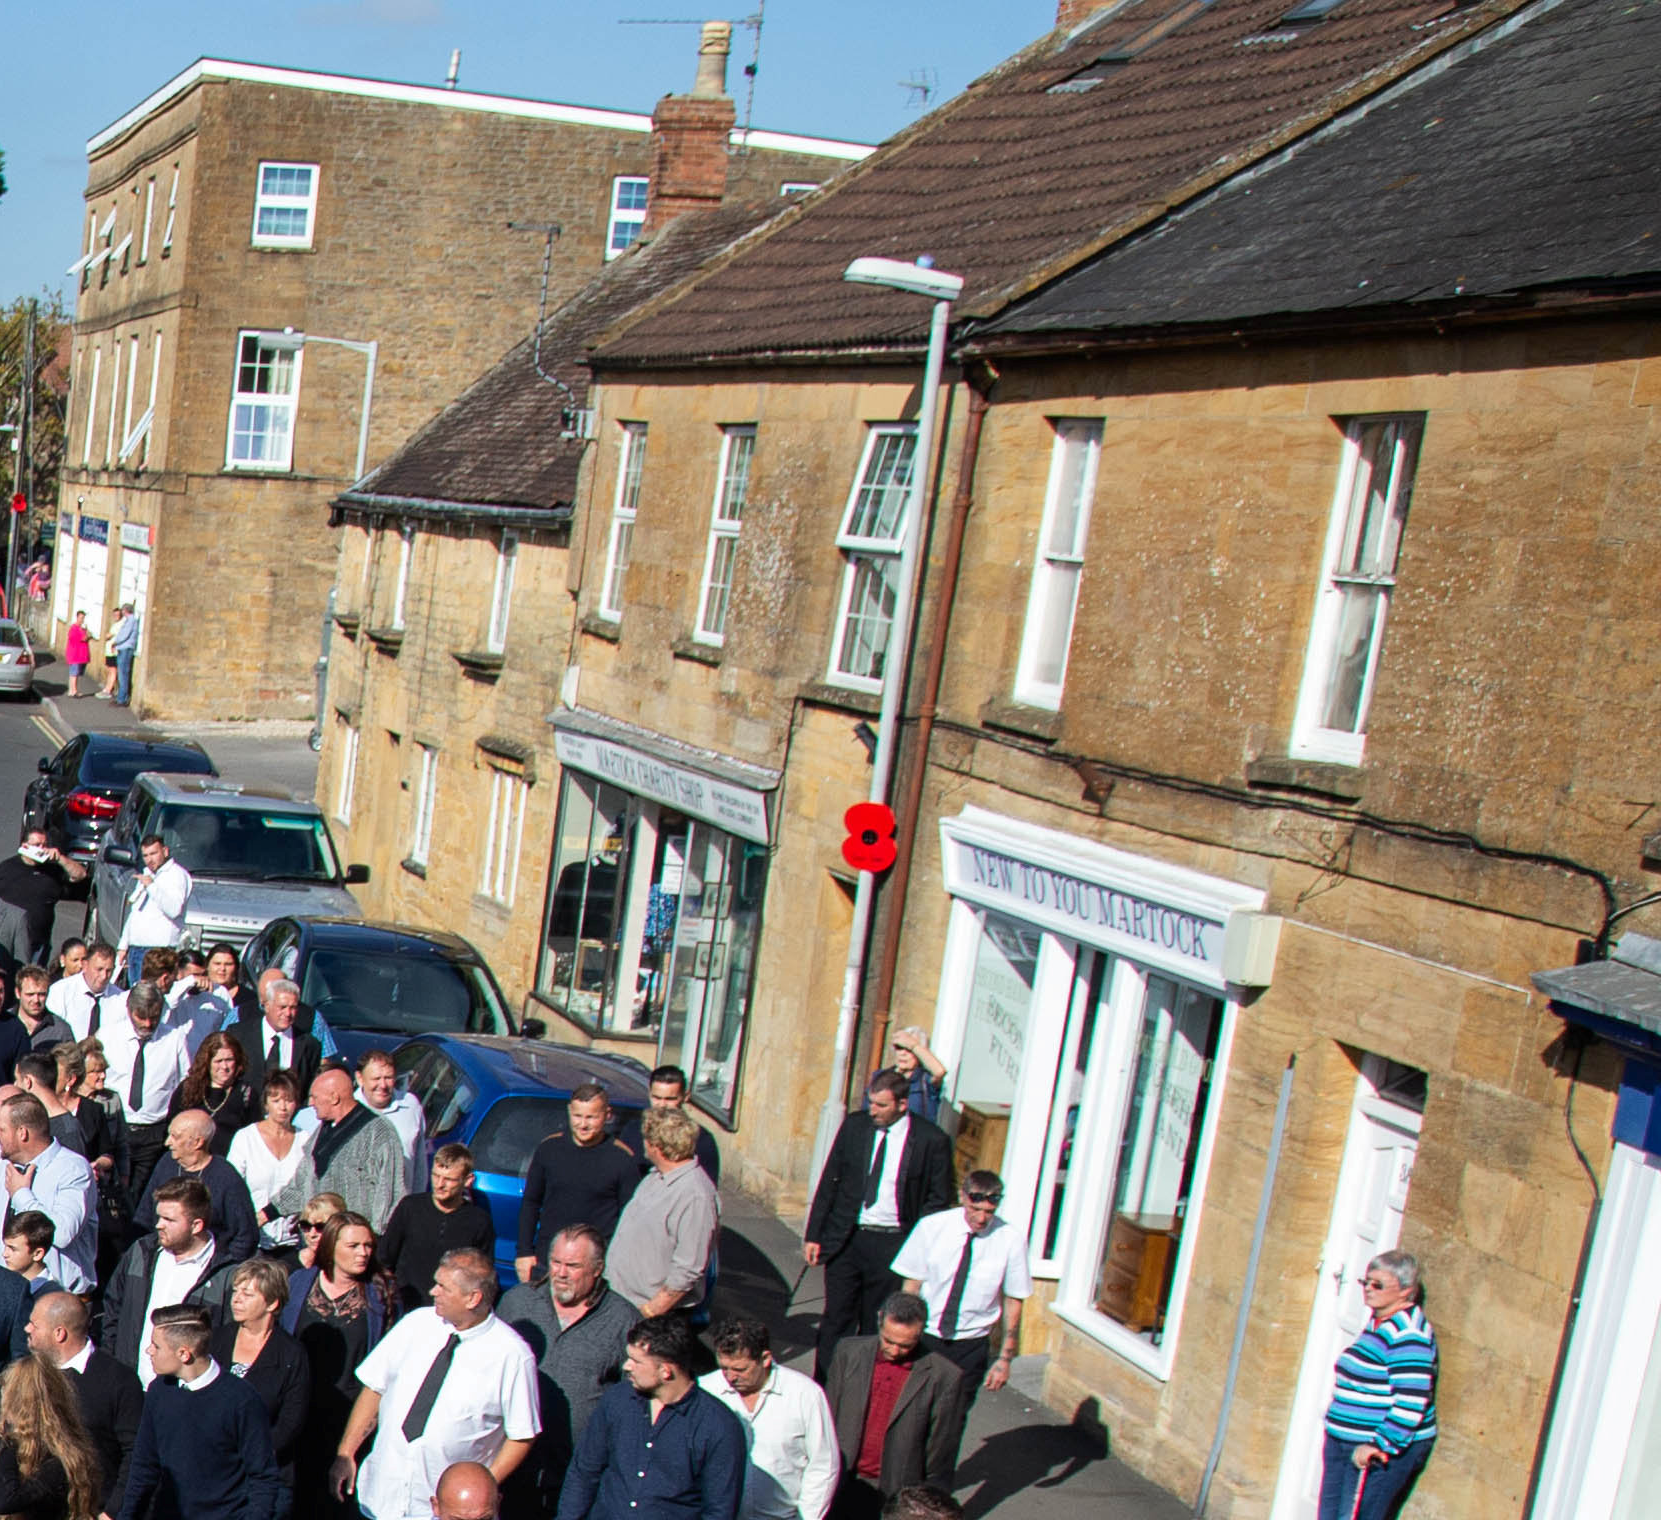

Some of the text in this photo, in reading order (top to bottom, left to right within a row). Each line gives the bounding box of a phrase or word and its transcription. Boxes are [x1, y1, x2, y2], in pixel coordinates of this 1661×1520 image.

[637, 760, 677, 798] CHARITY
[677, 776, 703, 810] SHOP
[973, 849, 1208, 961] NEW TO YOU MARTOCK
